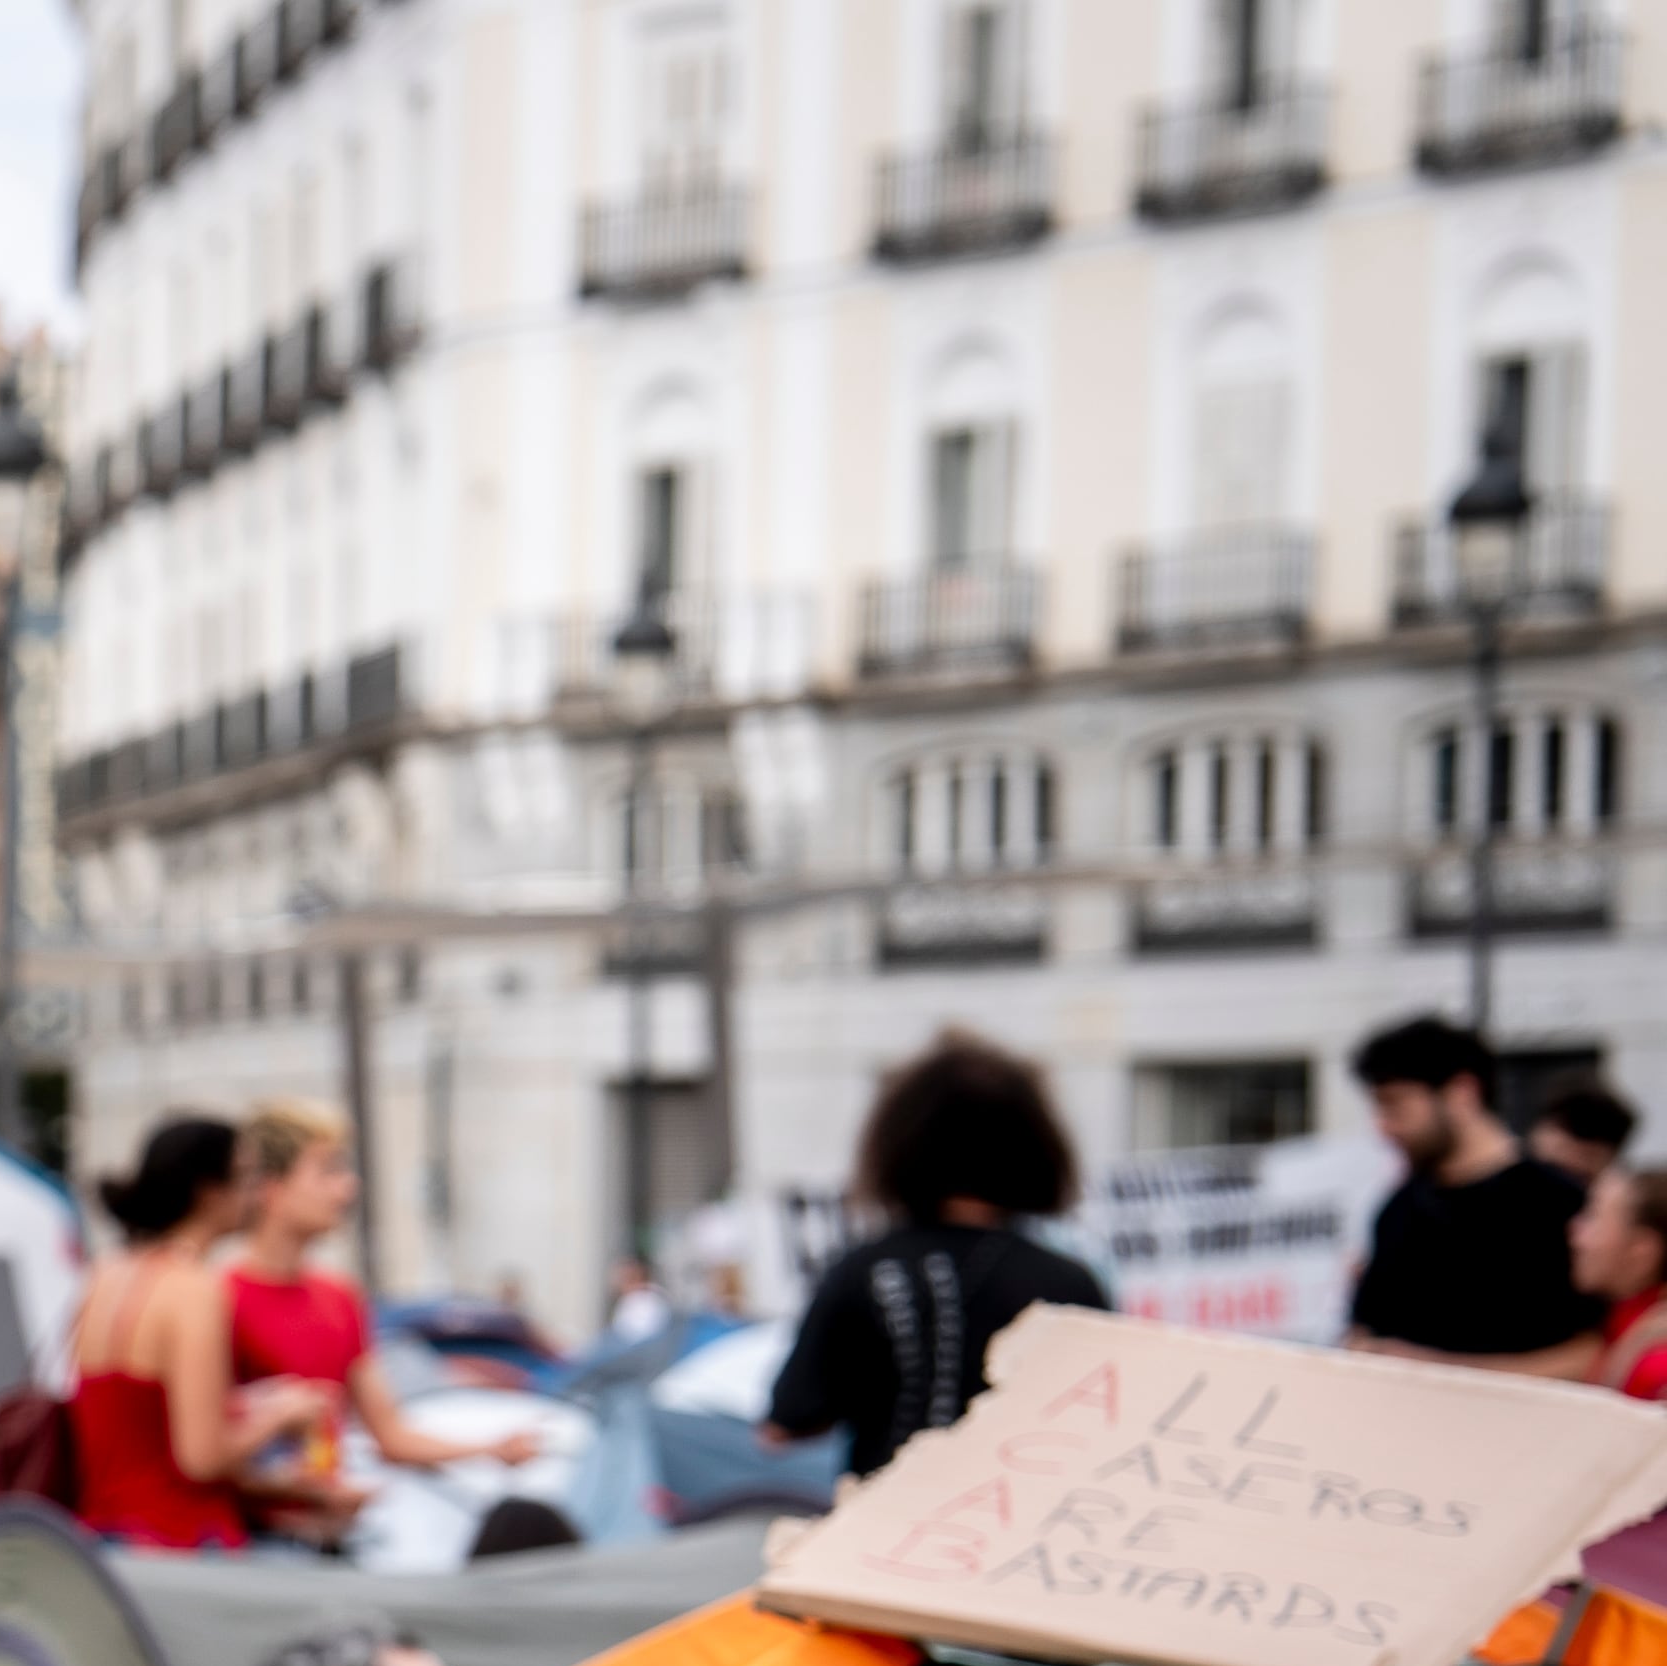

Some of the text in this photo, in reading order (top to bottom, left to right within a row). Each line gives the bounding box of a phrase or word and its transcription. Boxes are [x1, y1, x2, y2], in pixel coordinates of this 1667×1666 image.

[1040, 1358, 1307, 1461] ALL
[929, 1473, 1201, 1547] ARE
[996, 1431, 1482, 1538] CASEROS
[861, 1519, 1399, 1646] BASTARDS
